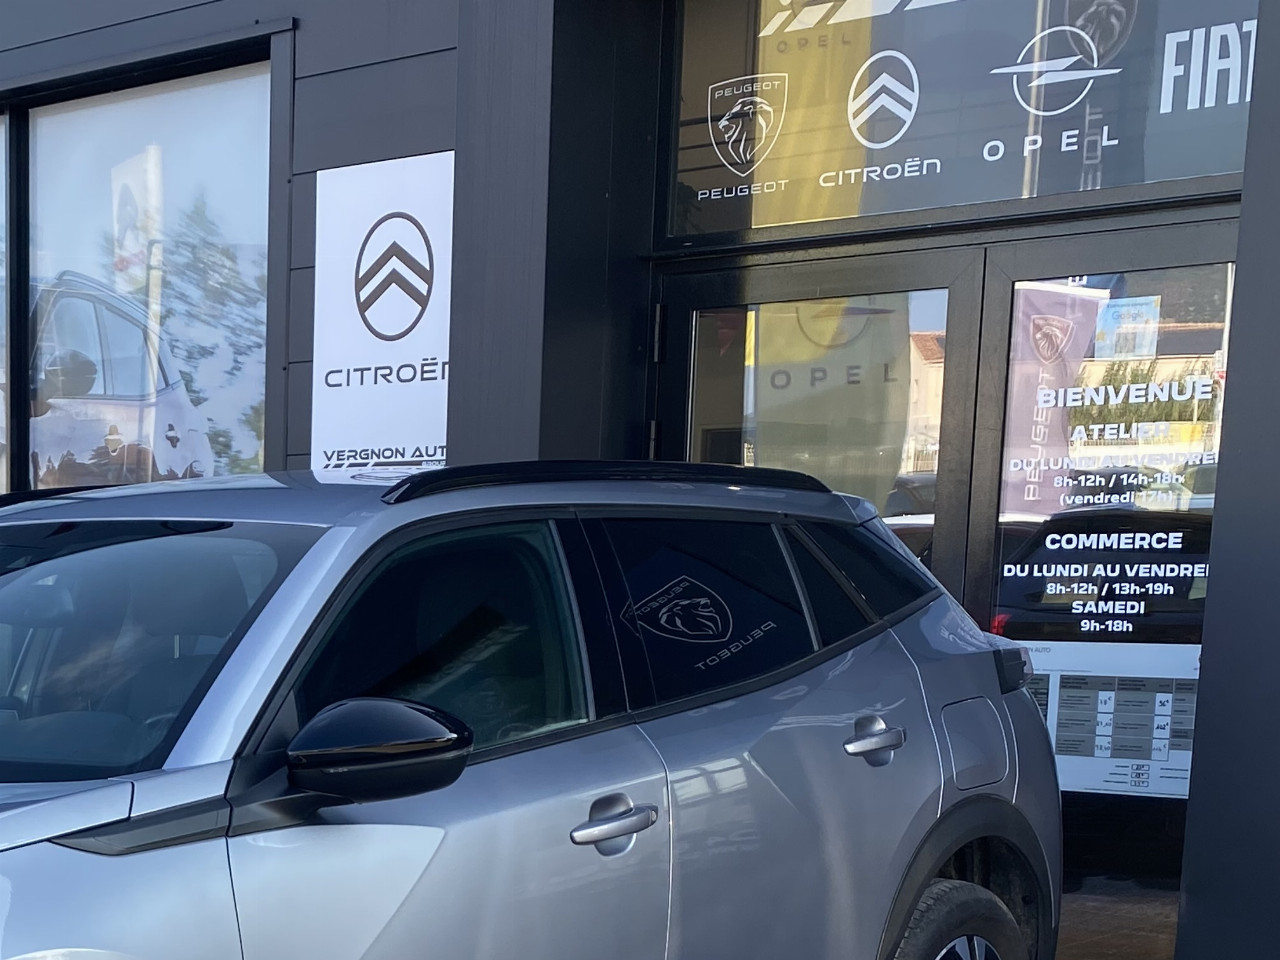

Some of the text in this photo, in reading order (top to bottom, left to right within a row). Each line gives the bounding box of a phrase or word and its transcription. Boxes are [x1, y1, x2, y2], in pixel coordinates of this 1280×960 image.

[1160, 19, 1258, 114] FIAT
[714, 81, 781, 99] PEUGEOT
[982, 125, 1119, 161] OPEL
[697, 179, 789, 200] PEUGEOT
[770, 363, 898, 389] OPEL
[1037, 379, 1213, 408] BIENVENUE
[1071, 422, 1169, 440] ATELIER
[323, 447, 406, 462] VERGNON
[1009, 458, 1037, 471] DU
[1053, 475, 1106, 487] 8h-12h
[1059, 491, 1135, 506] (vendredi
[1045, 532, 1184, 550] COMMERCE
[1003, 565, 1030, 577] DU
[1033, 565, 1088, 577] LUNDI
[1092, 565, 1121, 577] AU
[1046, 583, 1098, 595] 8h-12h
[1112, 583, 1174, 595] 13h-19h
[1071, 601, 1145, 615] SAMEDI
[1080, 620, 1133, 632] 9h-18h
